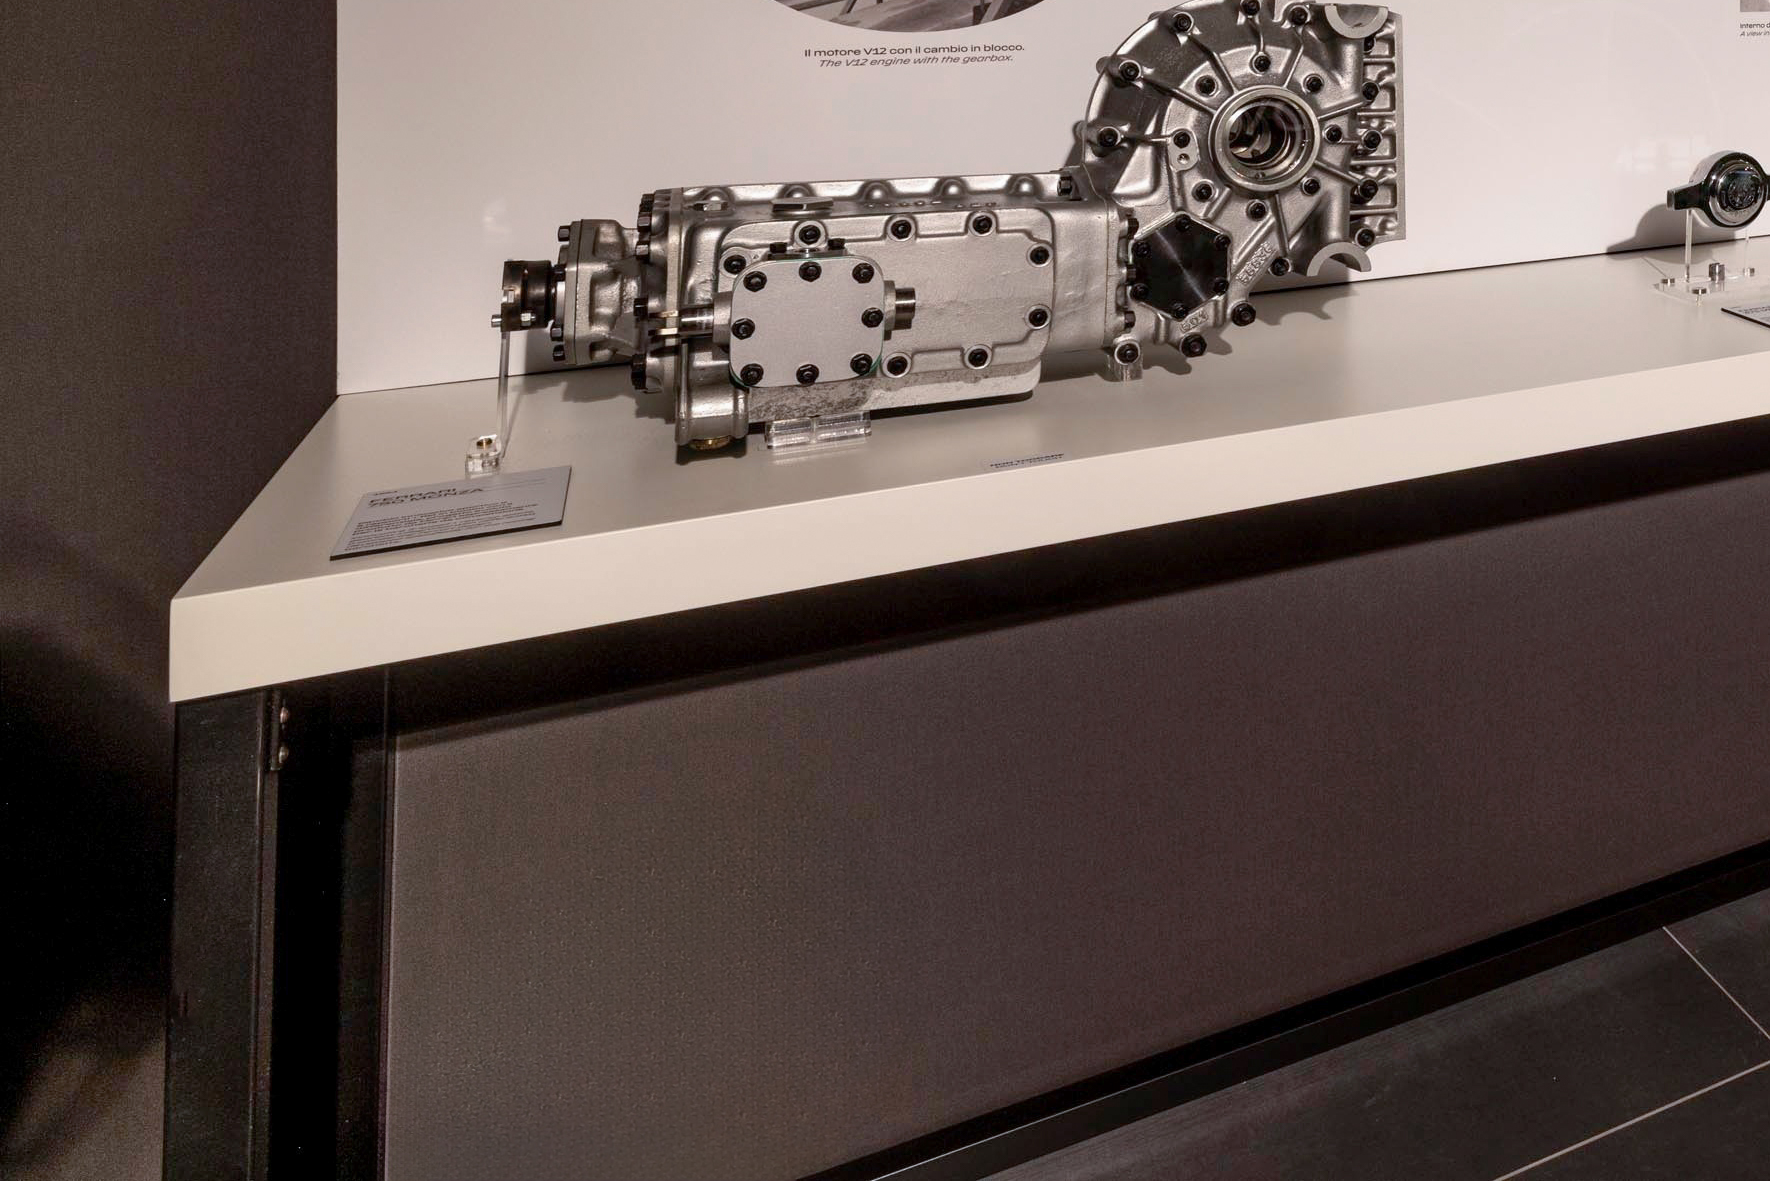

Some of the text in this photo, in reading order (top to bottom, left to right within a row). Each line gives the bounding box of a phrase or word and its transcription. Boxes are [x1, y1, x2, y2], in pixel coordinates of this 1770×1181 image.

[804, 43, 1025, 58] Il motore V12 con il cambio in blocco.
